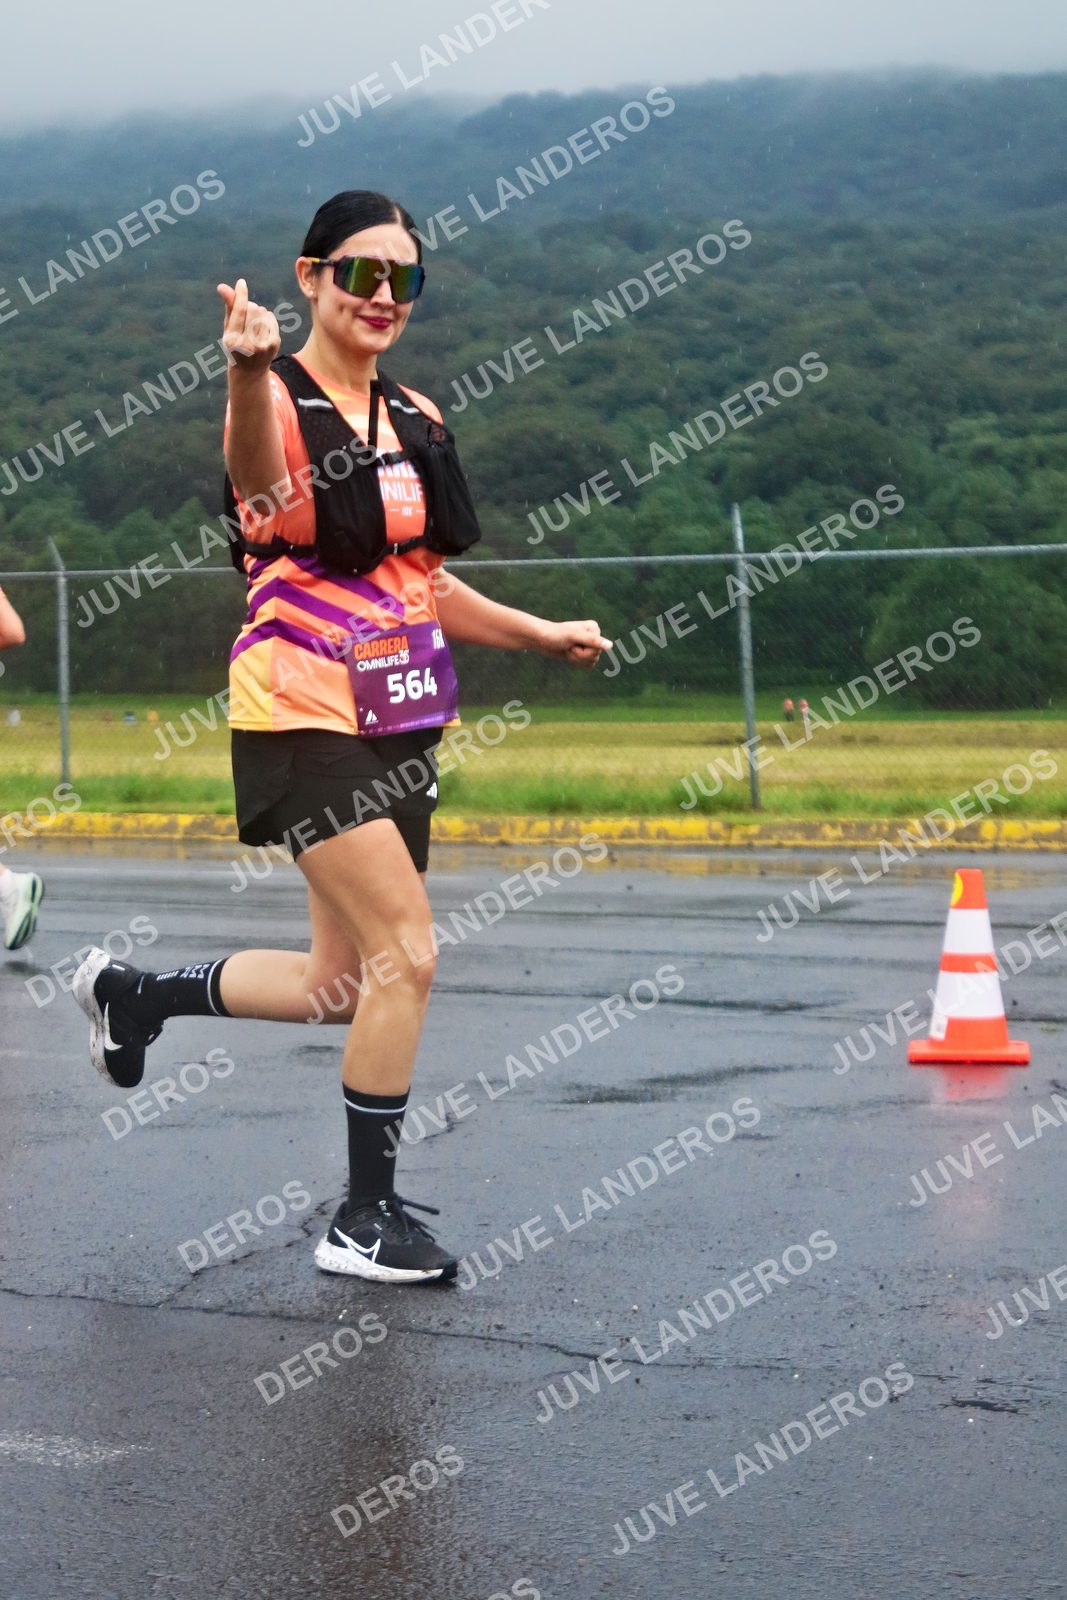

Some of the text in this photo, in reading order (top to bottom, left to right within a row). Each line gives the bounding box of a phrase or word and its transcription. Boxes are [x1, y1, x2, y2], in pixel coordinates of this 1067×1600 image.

[354, 635, 409, 660] CARRERA
[357, 654, 399, 672] OMNILIFE
[387, 667, 438, 704] 564
